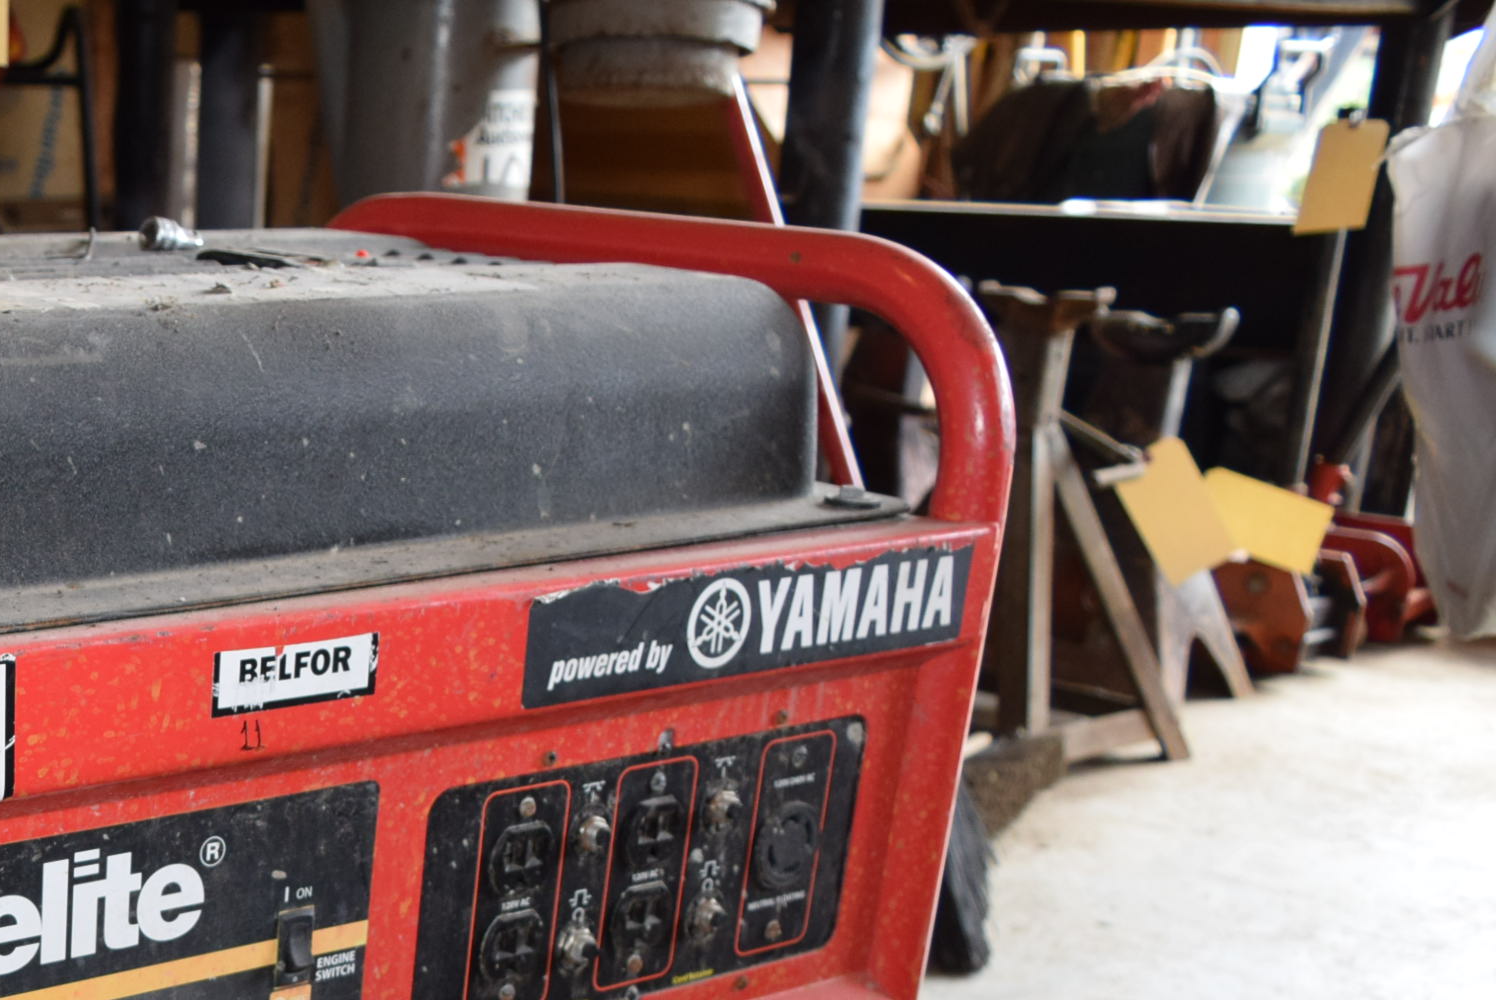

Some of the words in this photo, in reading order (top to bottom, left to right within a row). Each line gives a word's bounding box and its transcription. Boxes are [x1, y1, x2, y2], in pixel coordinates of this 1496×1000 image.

[547, 642, 642, 691] powered
[644, 640, 673, 674] by
[758, 555, 955, 655] YAMAHA
[239, 646, 352, 683] BELFOR
[296, 886, 313, 900] ON
[316, 950, 356, 968] ENGINE
[315, 963, 355, 982] SWITCH
